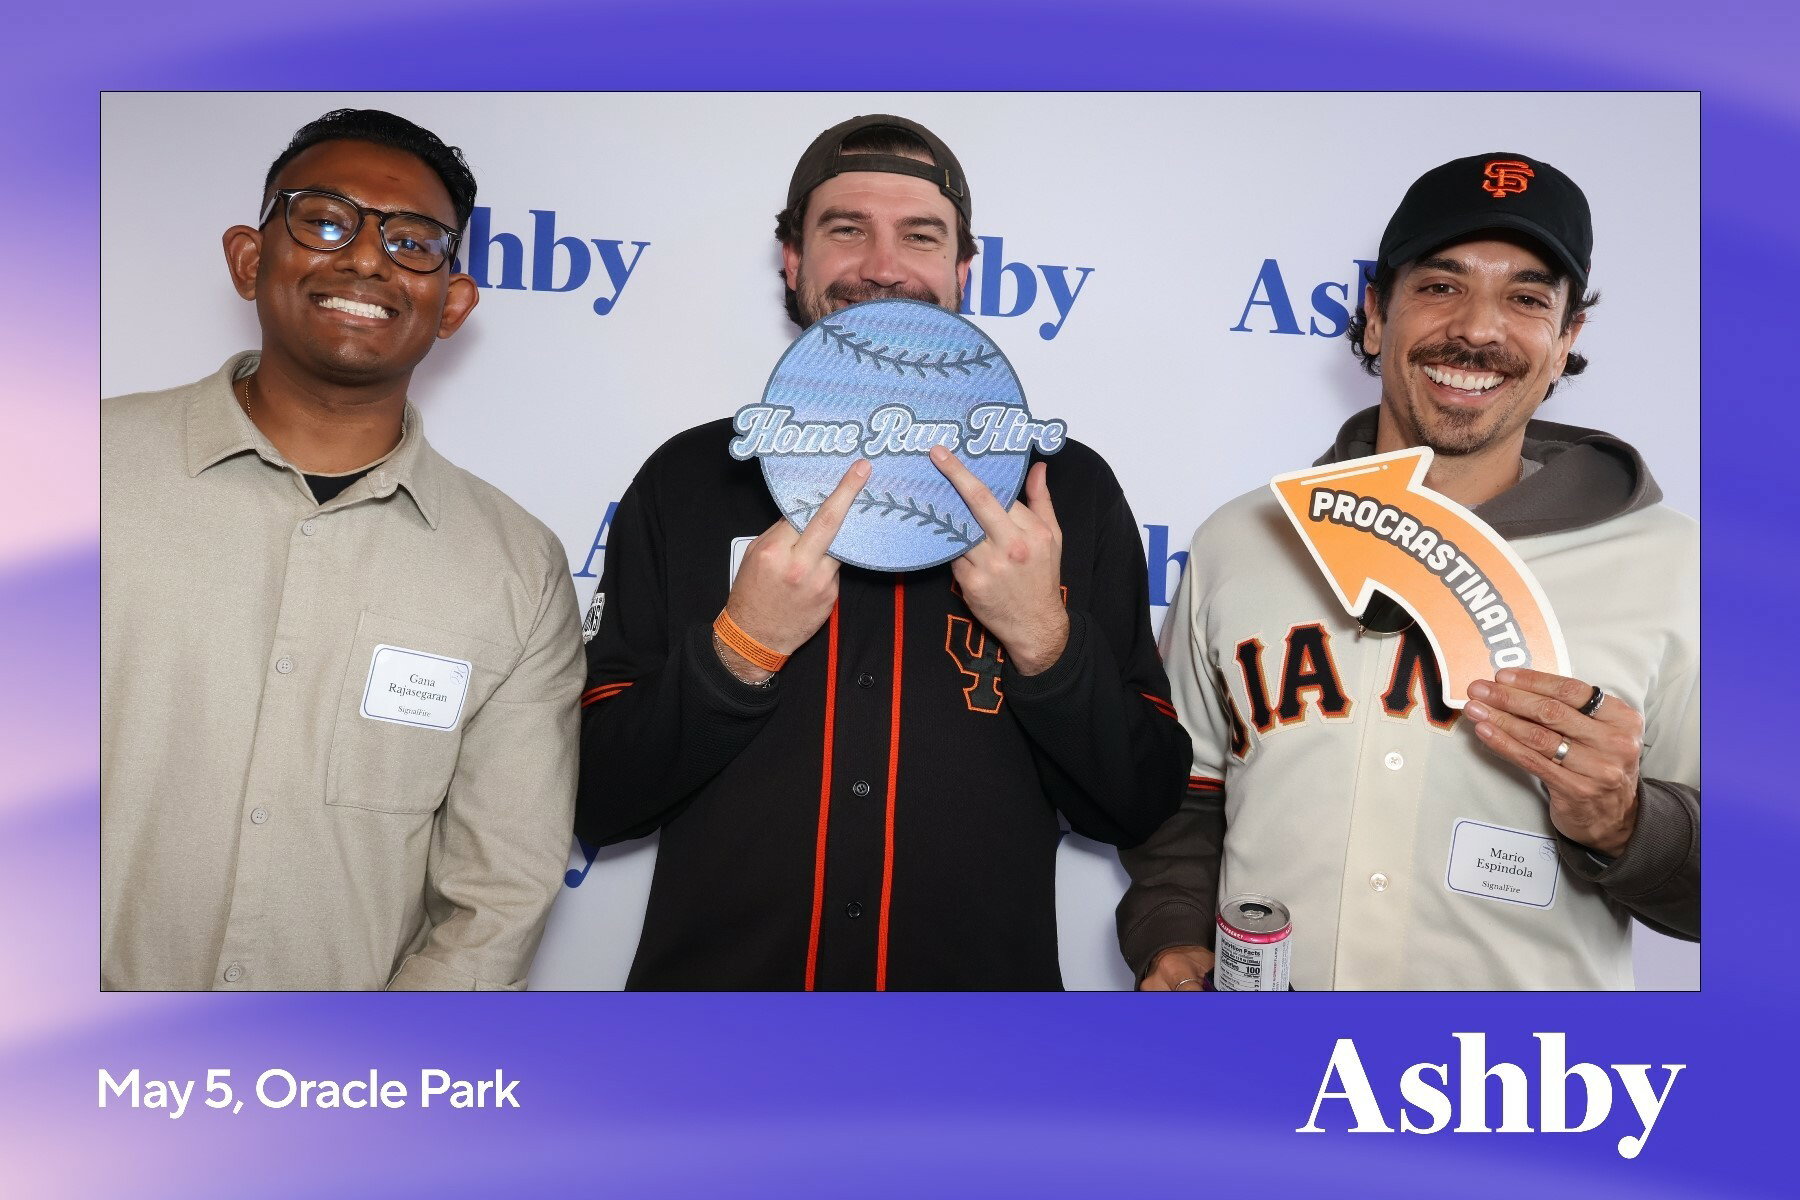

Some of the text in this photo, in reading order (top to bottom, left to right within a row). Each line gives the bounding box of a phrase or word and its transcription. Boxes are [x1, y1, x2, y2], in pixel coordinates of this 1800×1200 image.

[450, 206, 651, 316] hby
[959, 235, 1096, 341] by
[732, 405, 1065, 457] Home Run Hire
[1312, 491, 1527, 669] PROCRASTINATO
[409, 673, 436, 688] Gana
[388, 682, 448, 703] Rajasegaran
[398, 705, 431, 718] SignalFire
[1490, 847, 1525, 863] Mario
[1476, 858, 1533, 878] Espindola
[1481, 880, 1521, 894] SignalFire
[1243, 948, 1261, 957] Facts
[1246, 966, 1261, 975] 100
